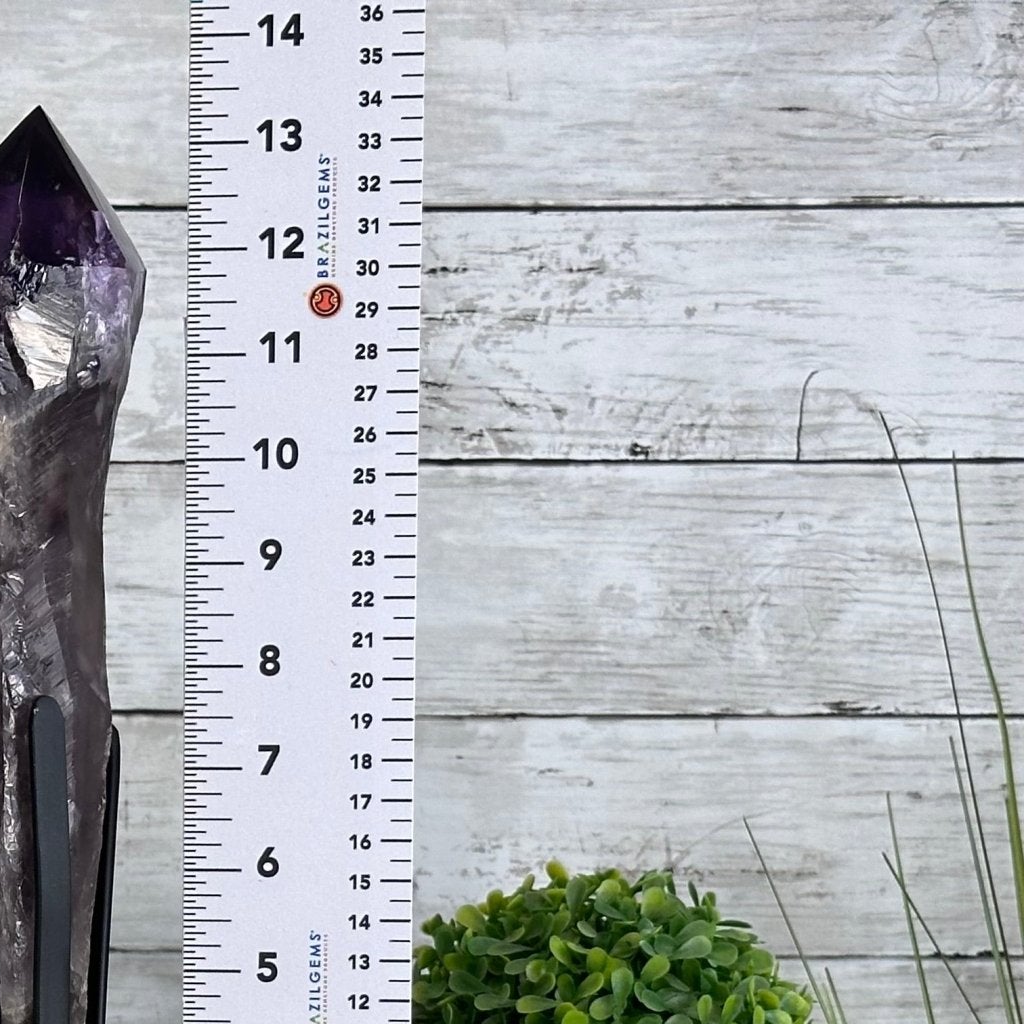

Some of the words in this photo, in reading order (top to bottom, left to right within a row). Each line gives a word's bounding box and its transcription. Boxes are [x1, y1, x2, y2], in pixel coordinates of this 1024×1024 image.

[360, 4, 384, 22] 36
[257, 13, 305, 47] 14
[359, 47, 383, 65] 35
[358, 90, 383, 108] 34
[256, 118, 303, 152] 13
[358, 132, 382, 150] 33
[357, 175, 381, 193] 32
[317, 156, 330, 279] BRAZILGEMS
[358, 217, 379, 235] 31
[258, 226, 305, 260] 12
[356, 259, 380, 277] 30
[355, 301, 379, 319] 29
[259, 330, 301, 364] 11
[354, 343, 378, 360] 28
[353, 384, 378, 402] 27
[353, 426, 377, 443] 26
[252, 437, 299, 470] 10
[353, 467, 376, 485] 25
[352, 509, 376, 526] 24
[259, 538, 283, 571] 9
[352, 549, 375, 567] 23
[351, 590, 375, 608] 22
[352, 631, 373, 648] 21
[259, 644, 281, 677] 8
[350, 672, 374, 689] 20
[350, 713, 373, 730] 19
[257, 744, 281, 776] 7
[350, 753, 372, 770] 18
[349, 793, 372, 810] 17
[349, 833, 372, 850] 16
[256, 846, 280, 878] 6
[349, 874, 371, 890] 15
[348, 914, 371, 931] 14
[256, 951, 278, 983] 5
[348, 954, 370, 970] 13
[347, 994, 370, 1010] 12
